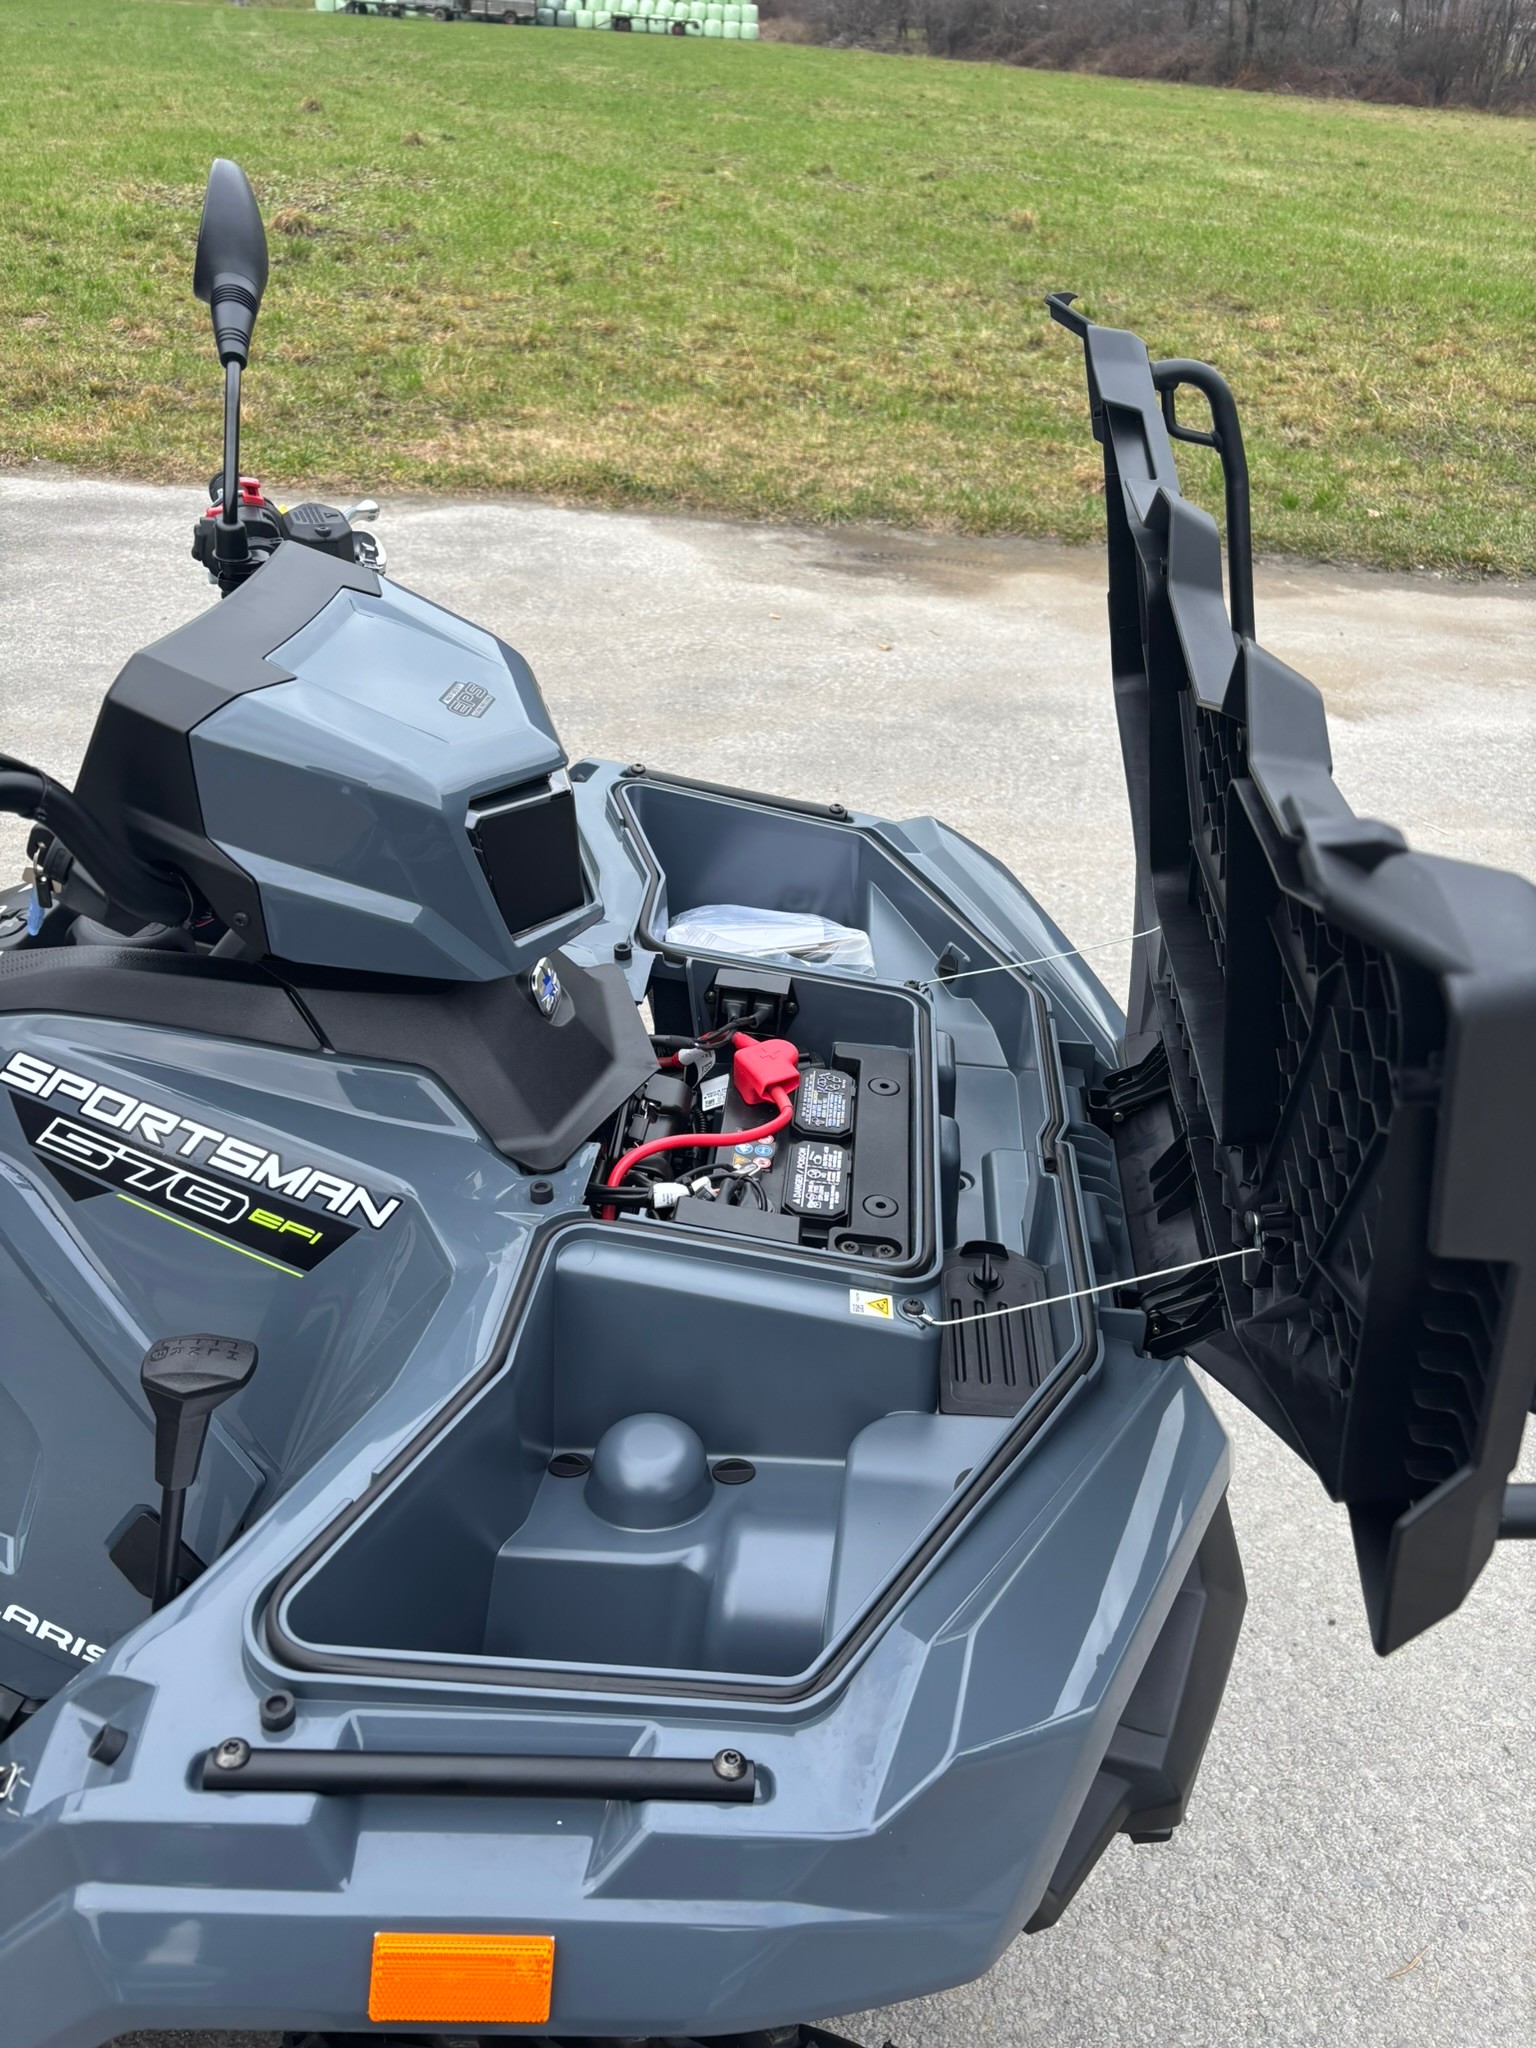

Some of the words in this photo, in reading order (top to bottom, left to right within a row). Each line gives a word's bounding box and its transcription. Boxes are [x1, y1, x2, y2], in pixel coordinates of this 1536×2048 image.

[449, 682, 488, 716] EPS
[0, 1051, 403, 1230] SPORTSMAN
[796, 1147, 807, 1169] POISON
[36, 1117, 251, 1225] 570
[247, 1206, 323, 1245] EFI
[793, 1174, 804, 1198] DANGER
[0, 1604, 108, 1664] ARIS
